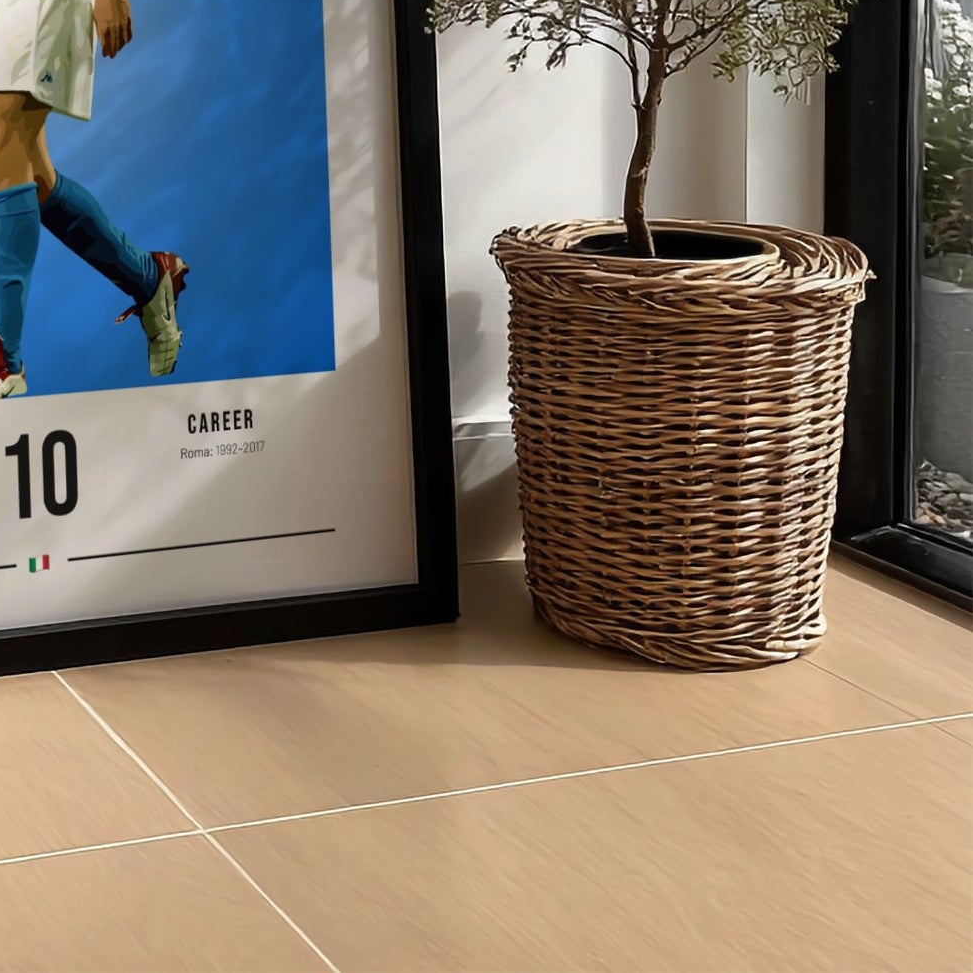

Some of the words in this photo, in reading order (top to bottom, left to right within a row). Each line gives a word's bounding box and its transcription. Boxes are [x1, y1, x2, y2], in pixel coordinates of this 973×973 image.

[187, 409, 253, 434] CAREER
[180, 446, 213, 459] Roma:
[5, 429, 78, 519] 10
